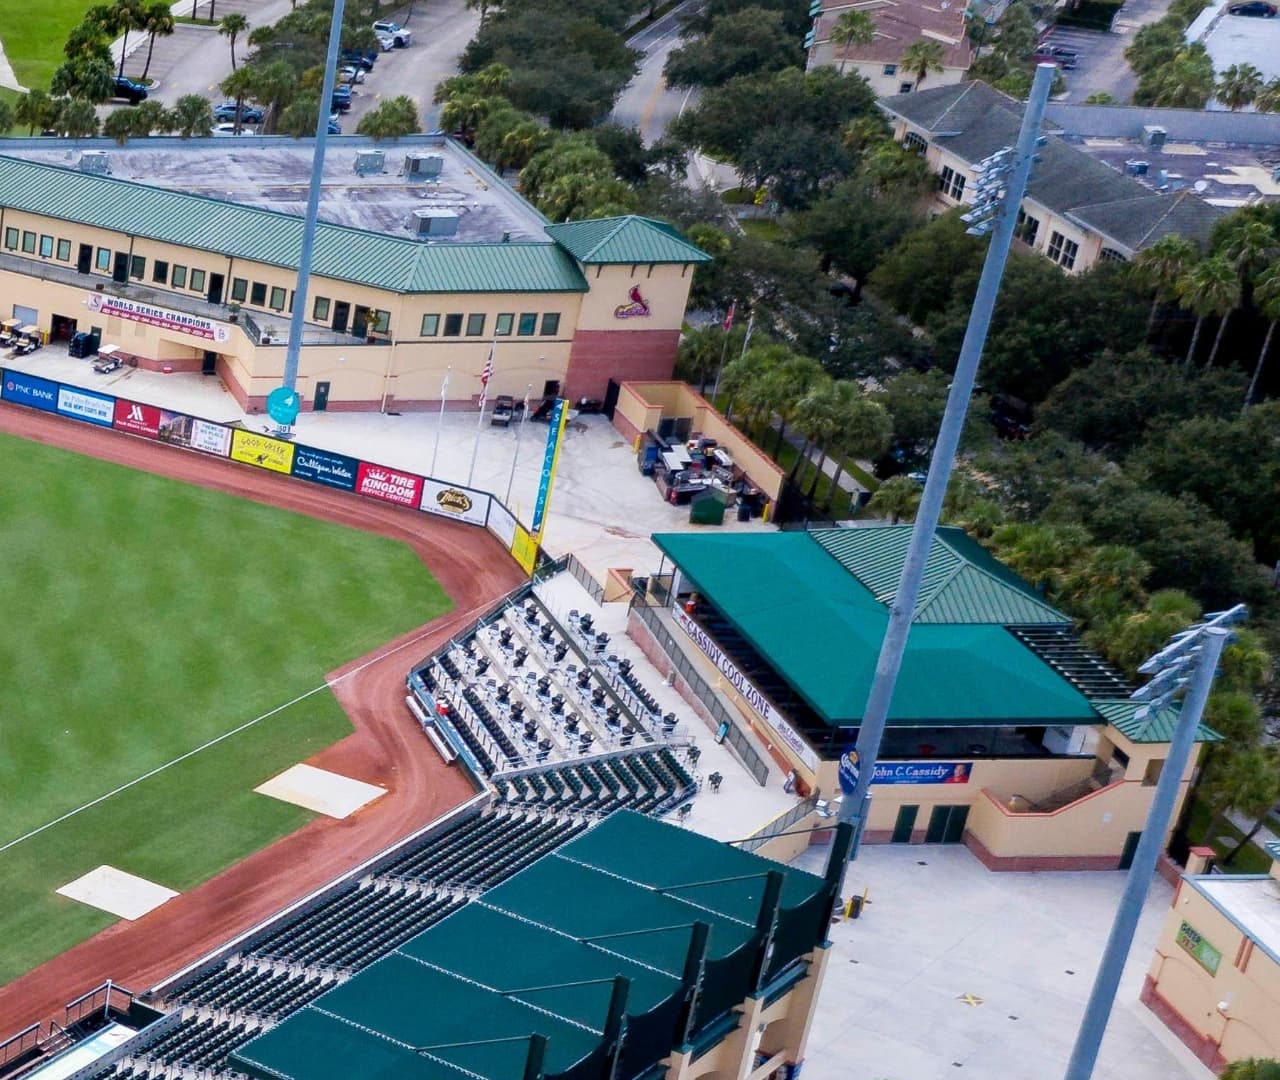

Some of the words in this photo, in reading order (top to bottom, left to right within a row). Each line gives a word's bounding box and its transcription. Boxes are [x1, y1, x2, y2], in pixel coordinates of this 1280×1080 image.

[107, 299, 134, 311] WORLD
[135, 305, 163, 318] SERIES
[166, 312, 211, 330] CHAMPIONS
[15, 384, 31, 395] PNC
[33, 389, 53, 400] BANK
[241, 438, 261, 448] GOOD
[297, 456, 331, 474] Culligan
[332, 465, 353, 479] Water
[535, 412, 561, 518] SEACOAST
[362, 477, 416, 500] KINGDOM
[390, 473, 416, 489] TIRE
[360, 487, 385, 498] SERVICE
[386, 493, 412, 505] CENTERS
[687, 620, 722, 669] CASSIDY
[722, 656, 745, 693] COOL
[746, 683, 771, 720] ZONE
[871, 766, 893, 780] John
[905, 765, 949, 779] Cassidy
